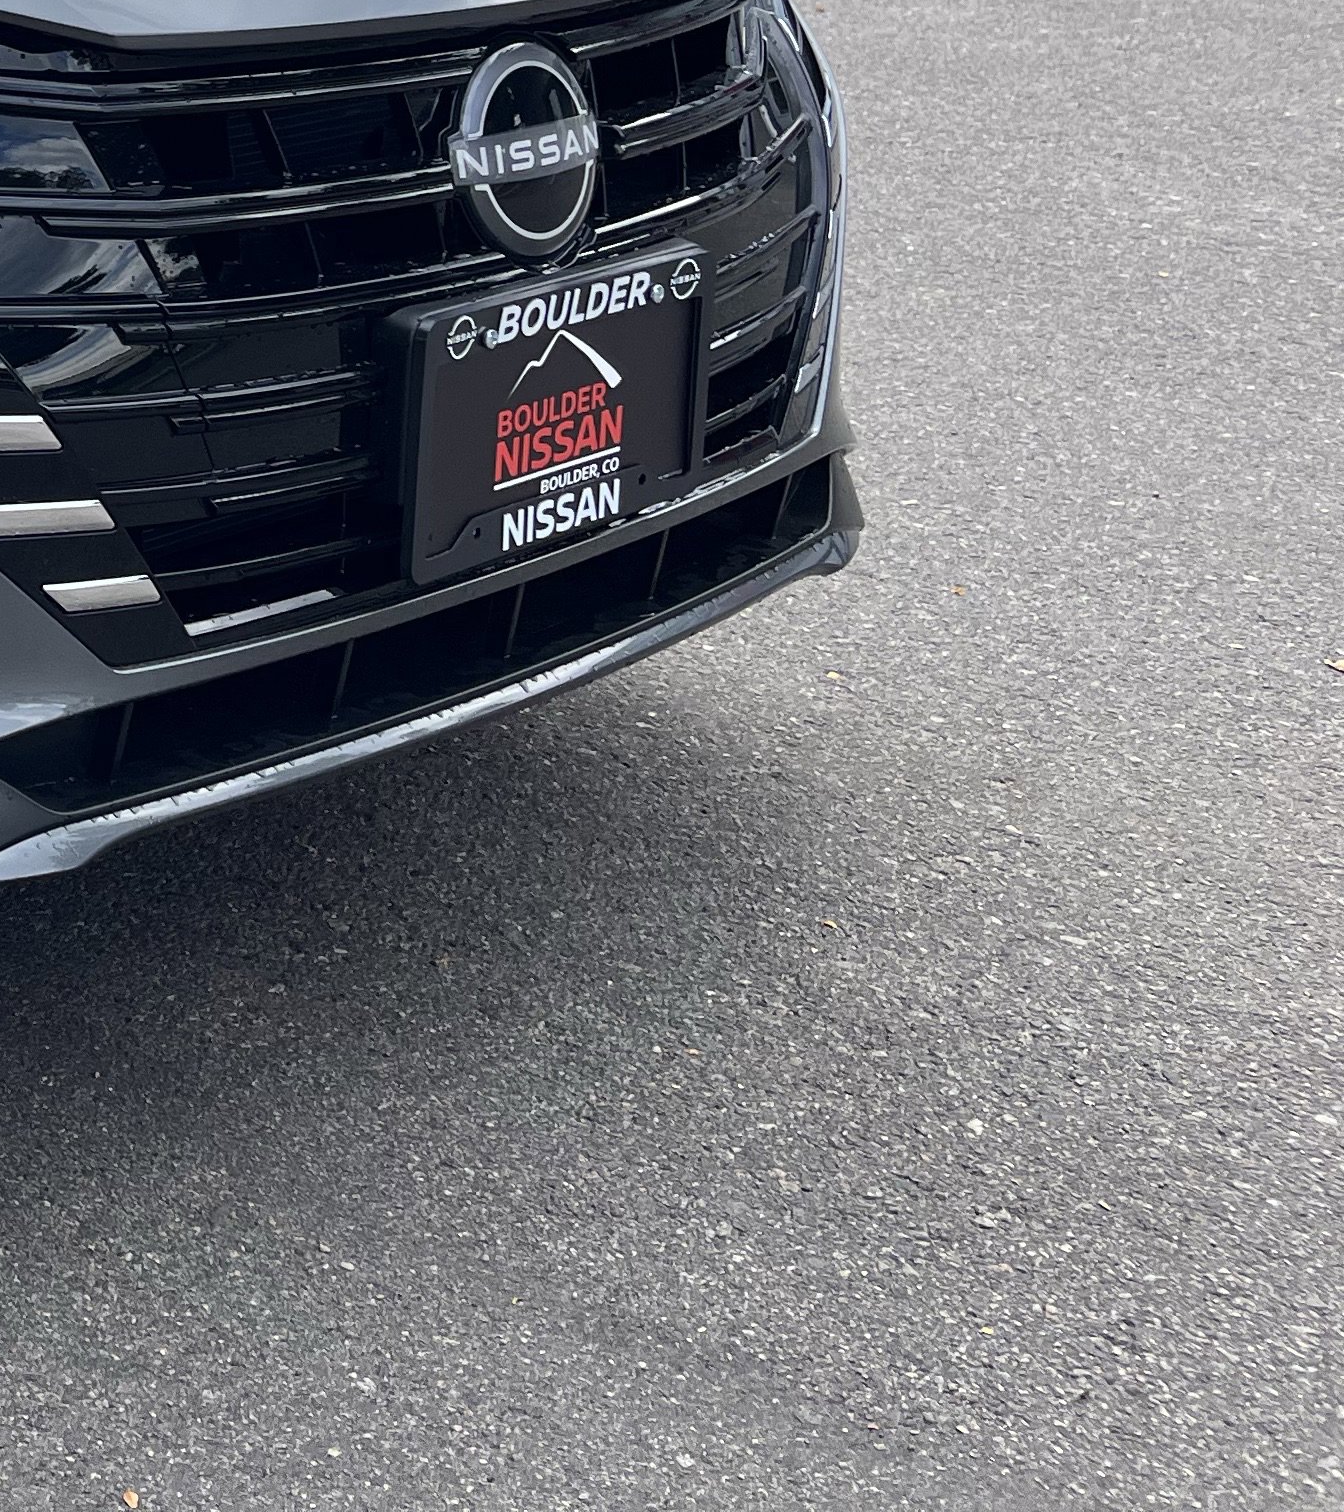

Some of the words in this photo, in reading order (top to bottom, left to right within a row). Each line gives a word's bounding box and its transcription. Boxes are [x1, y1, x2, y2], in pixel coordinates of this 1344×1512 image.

[455, 120, 600, 179] NISSAN
[497, 271, 651, 344] BOULDER
[670, 272, 701, 287] NISSAN
[446, 327, 478, 346] NISSAN
[496, 381, 607, 439] BOULDER
[494, 404, 624, 483] NISSAN
[539, 463, 601, 495] BOULDER,
[601, 456, 620, 473] CO
[501, 477, 621, 552] NISSAN
